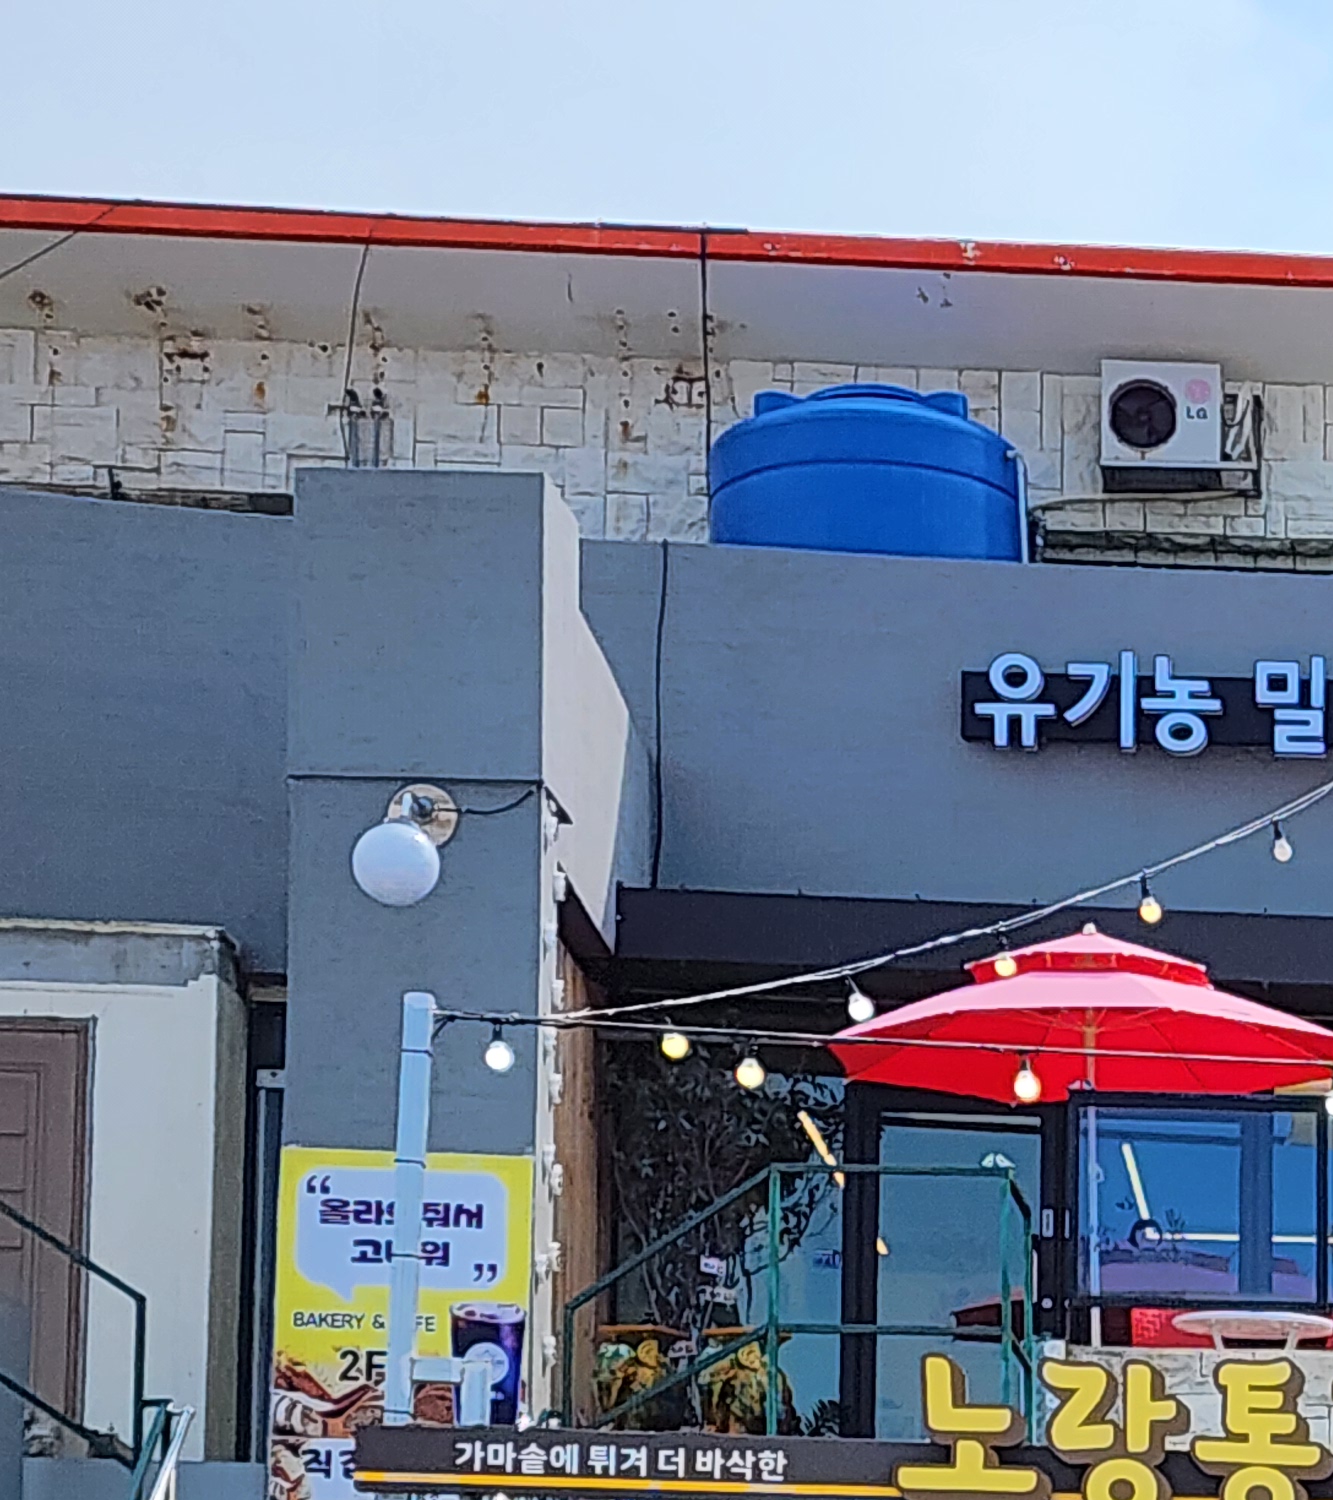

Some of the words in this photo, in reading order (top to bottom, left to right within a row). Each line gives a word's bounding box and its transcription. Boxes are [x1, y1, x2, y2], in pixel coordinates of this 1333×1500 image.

[974, 651, 1223, 754] 유기농
[1255, 656, 1326, 757] 밀
[351, 1239, 450, 1267] 고워
[293, 1312, 365, 1330] BAKERY
[372, 1315, 385, 1329] &
[339, 1350, 387, 1382] 2F
[455, 1440, 579, 1475] 가마솥에
[588, 1446, 648, 1478] 튀겨
[658, 1450, 686, 1476] 더
[695, 1452, 789, 1483] 바삭한
